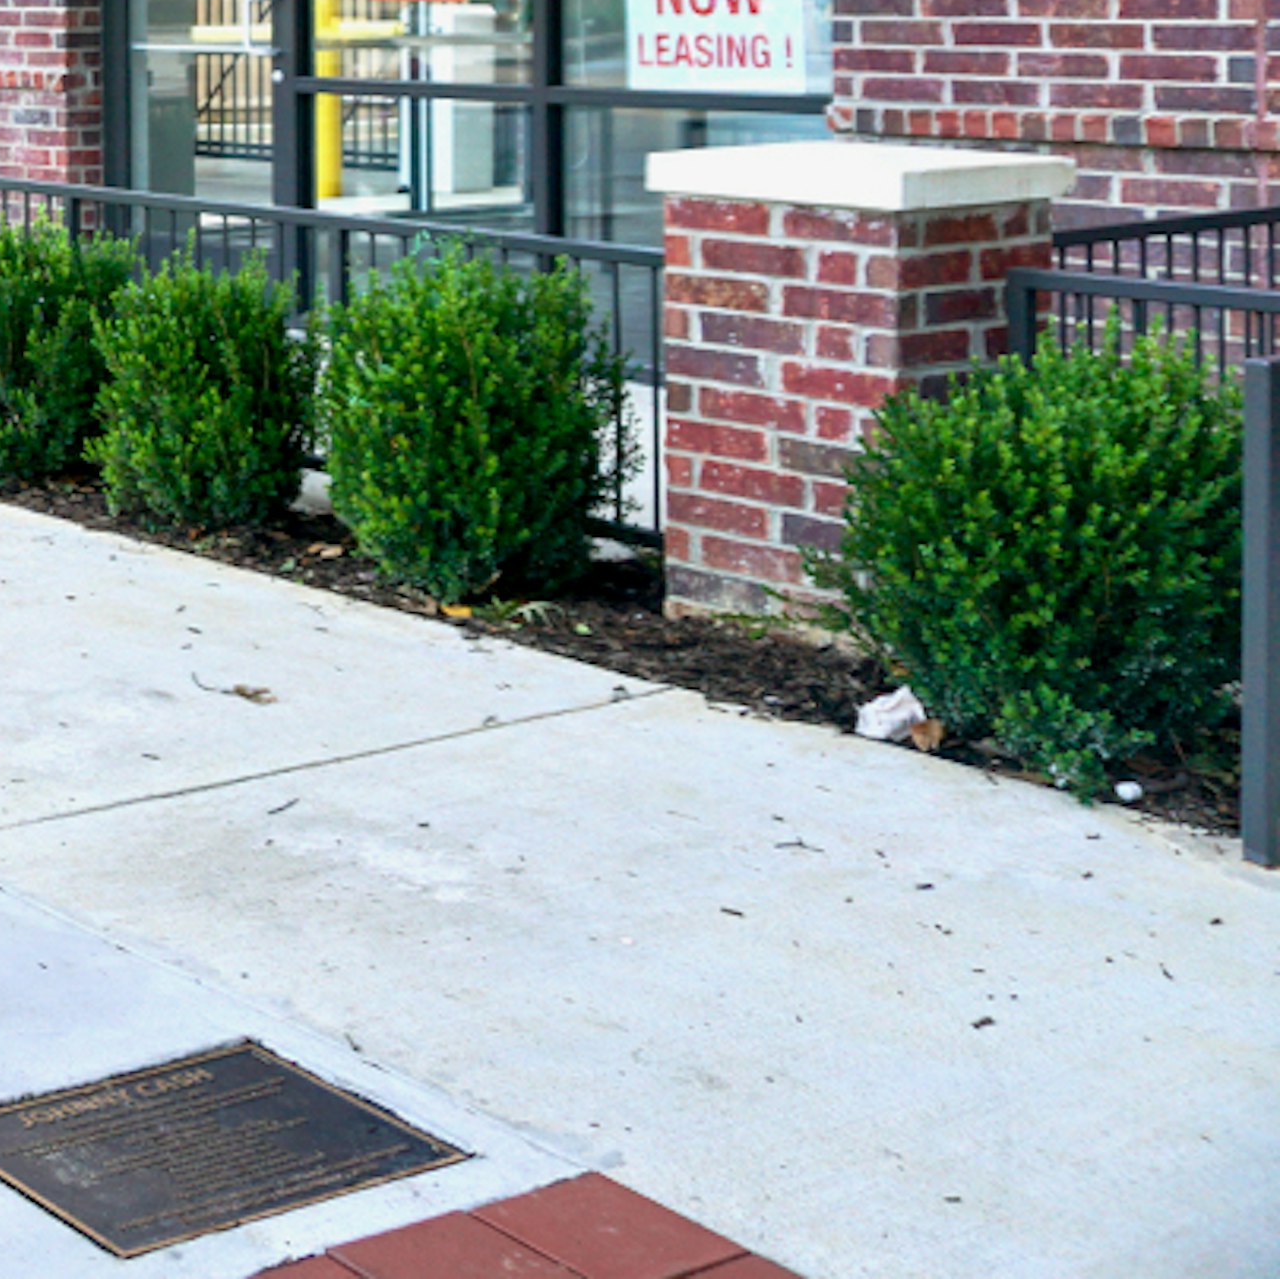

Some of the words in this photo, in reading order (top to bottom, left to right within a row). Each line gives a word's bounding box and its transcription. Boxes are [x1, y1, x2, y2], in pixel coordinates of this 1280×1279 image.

[637, 33, 772, 69] LEASING
[16, 1087, 132, 1129] JOHNNY
[134, 1067, 215, 1098] CASH
